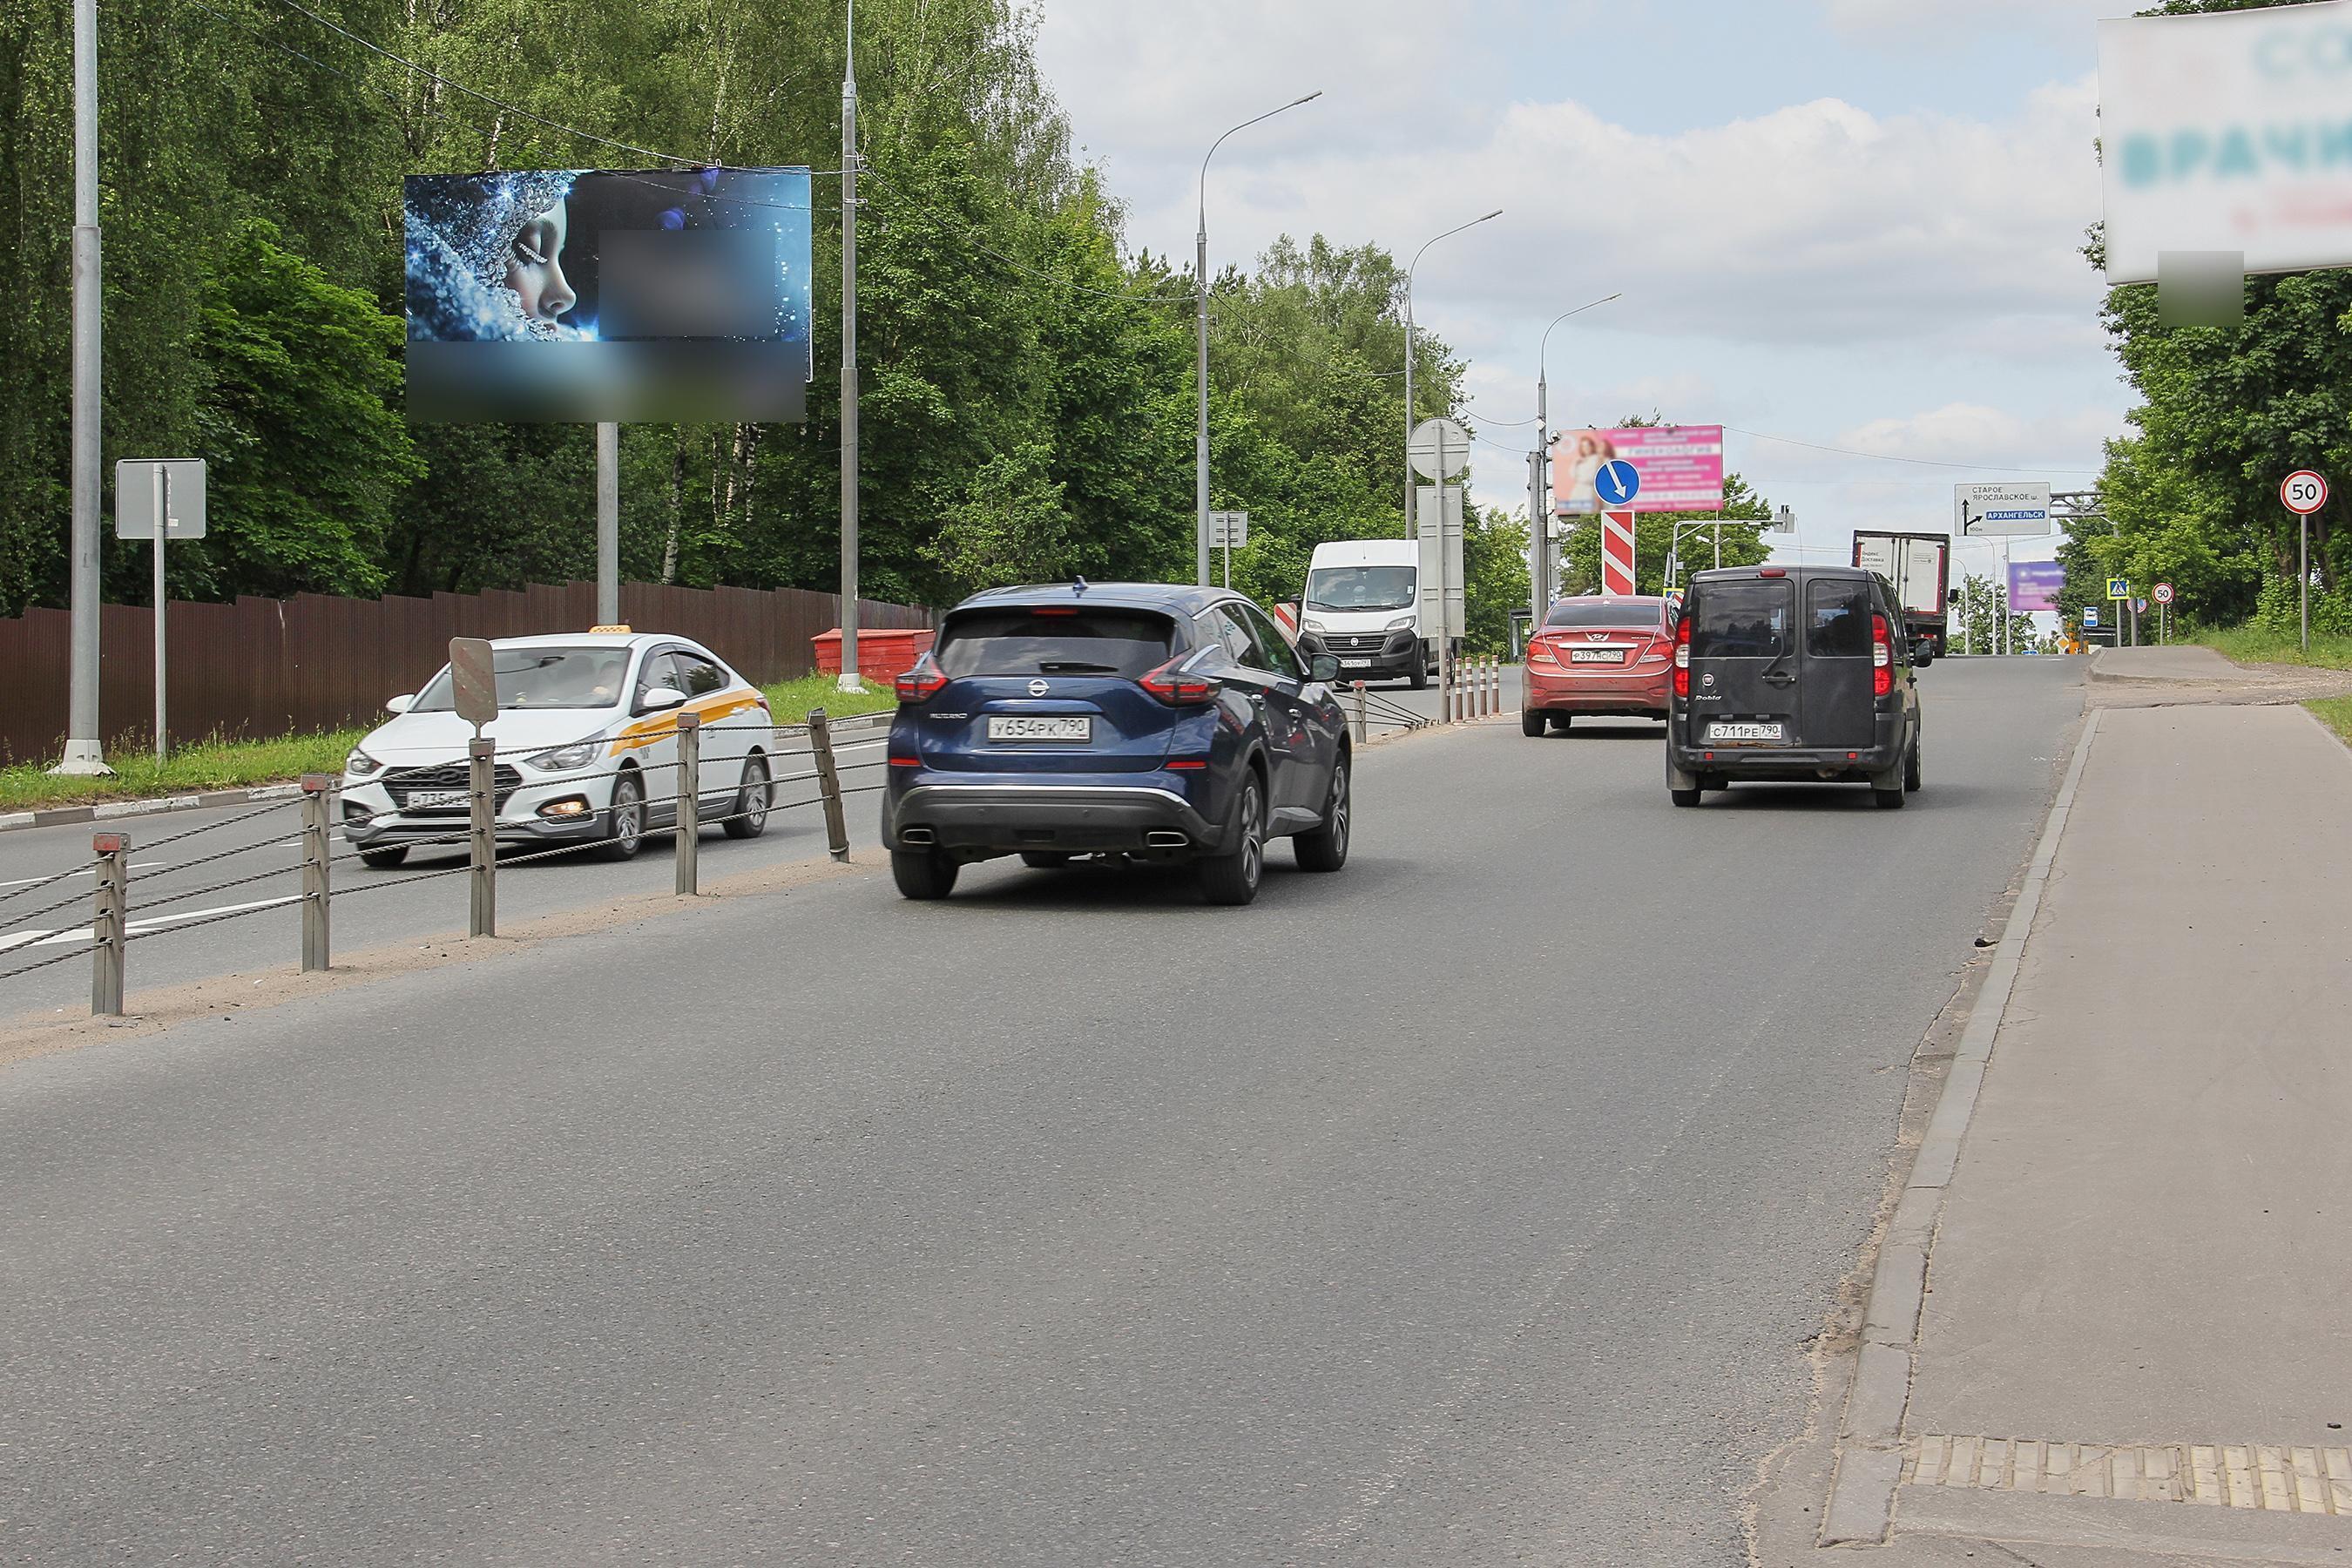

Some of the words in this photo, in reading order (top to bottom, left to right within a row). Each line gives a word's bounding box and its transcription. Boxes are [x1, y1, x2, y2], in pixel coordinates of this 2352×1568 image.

[2293, 483, 2316, 500] 50
[1987, 510, 2044, 519] АРХАНГЕЛЬСК
[1713, 726, 1759, 737] С711РЕ
